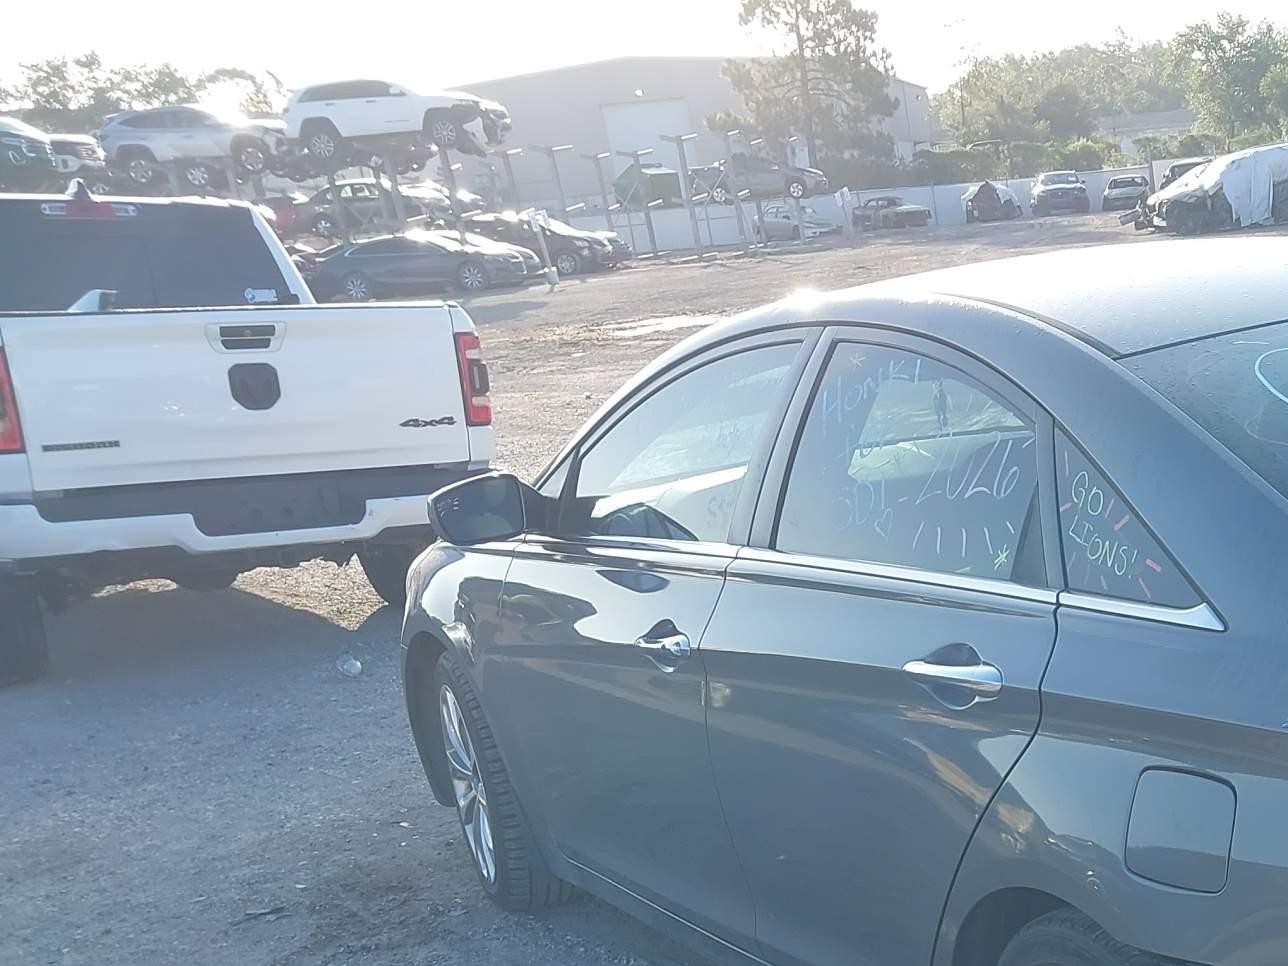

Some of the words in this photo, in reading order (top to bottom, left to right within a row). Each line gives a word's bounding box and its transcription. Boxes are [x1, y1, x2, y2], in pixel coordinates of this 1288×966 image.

[399, 416, 457, 427] 4x4
[915, 432, 1021, 504] 2026
[1069, 515, 1137, 579] LIONS!
